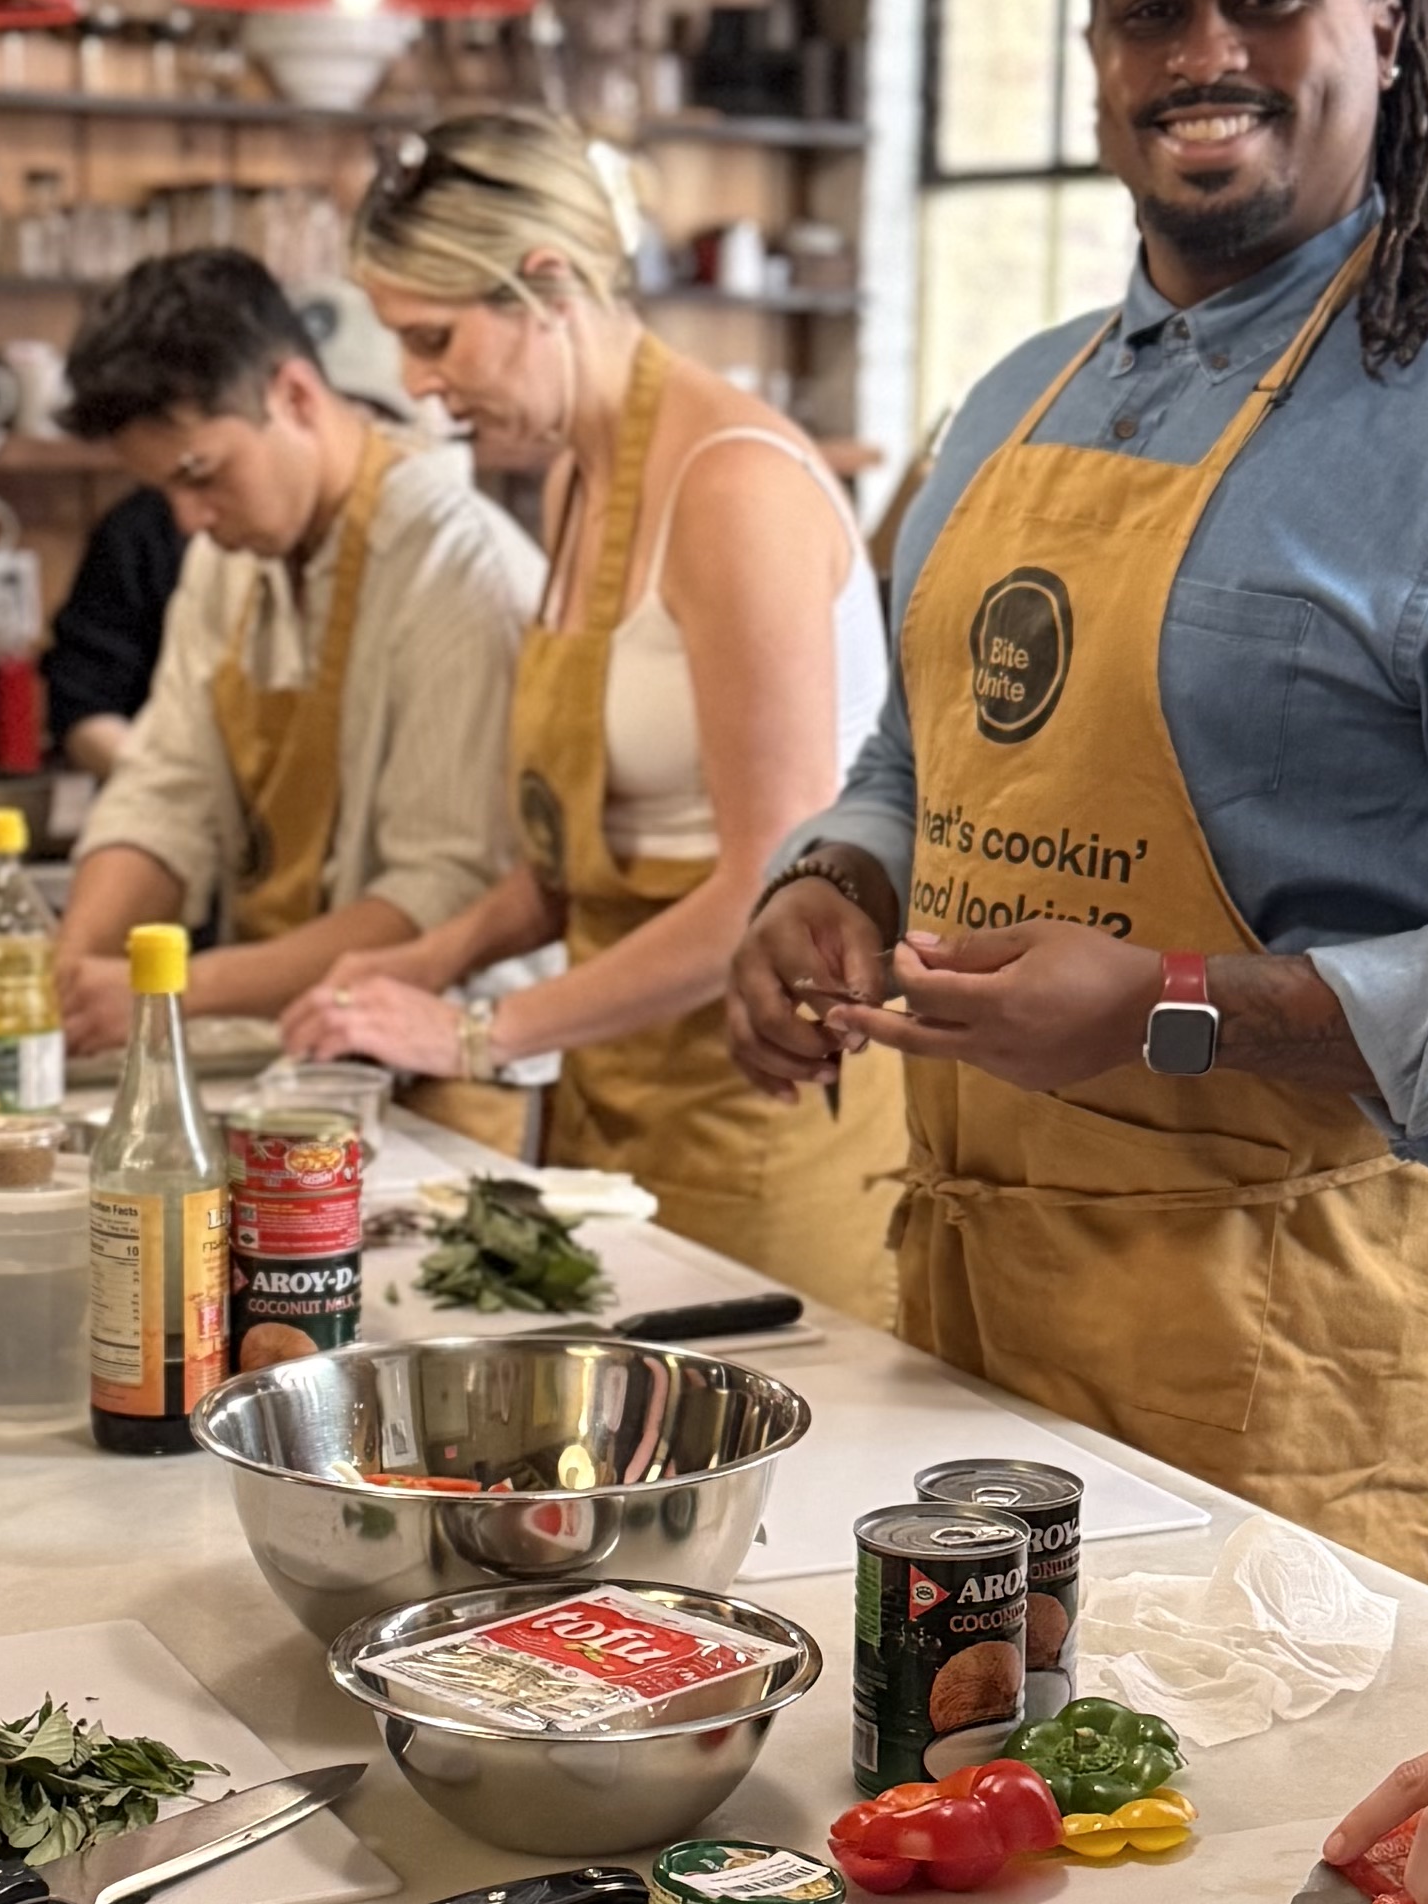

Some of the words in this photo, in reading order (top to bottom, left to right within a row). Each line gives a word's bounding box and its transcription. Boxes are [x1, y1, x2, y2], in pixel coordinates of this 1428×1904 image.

[991, 637, 1029, 669] Bite
[976, 668, 1025, 702] Unite
[922, 797, 975, 853] hat's
[982, 827, 1148, 883] cookin'
[113, 1205, 138, 1217] Facts
[127, 1246, 139, 1256] 10
[252, 1267, 353, 1294] AROY-D
[248, 1298, 321, 1315] COCONUT
[531, 1612, 671, 1664] tofu
